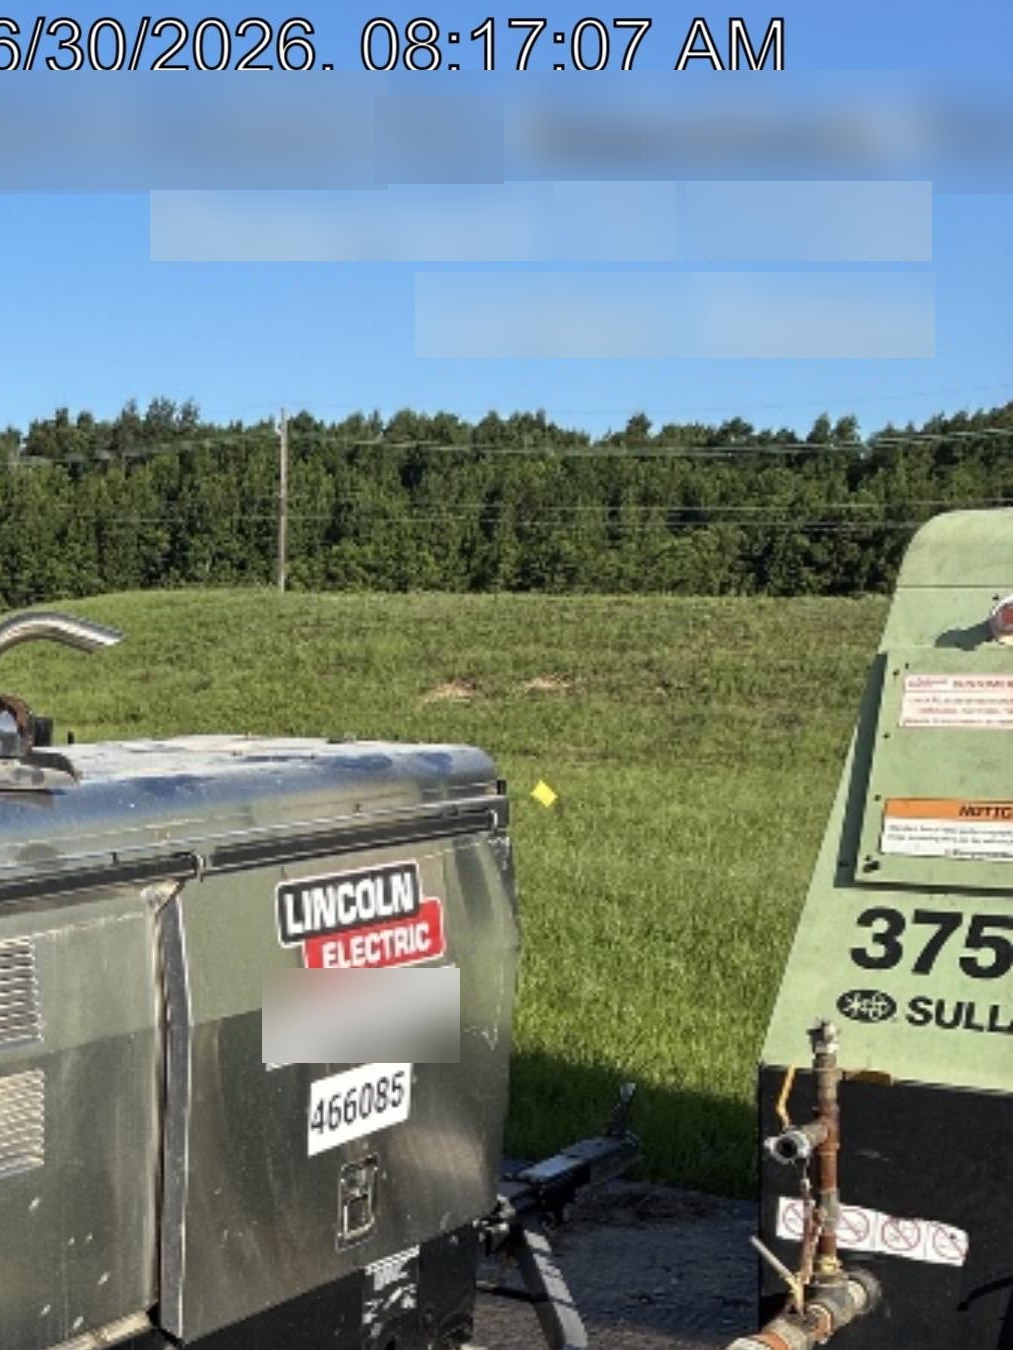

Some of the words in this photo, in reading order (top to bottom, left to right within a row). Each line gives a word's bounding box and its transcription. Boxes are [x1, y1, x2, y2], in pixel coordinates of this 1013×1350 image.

[284, 871, 414, 935] LINCOLN
[321, 922, 432, 968] ELECTRIC
[850, 906, 1013, 979] 375
[906, 995, 1013, 1034] SULL
[310, 1070, 405, 1134] 466085
